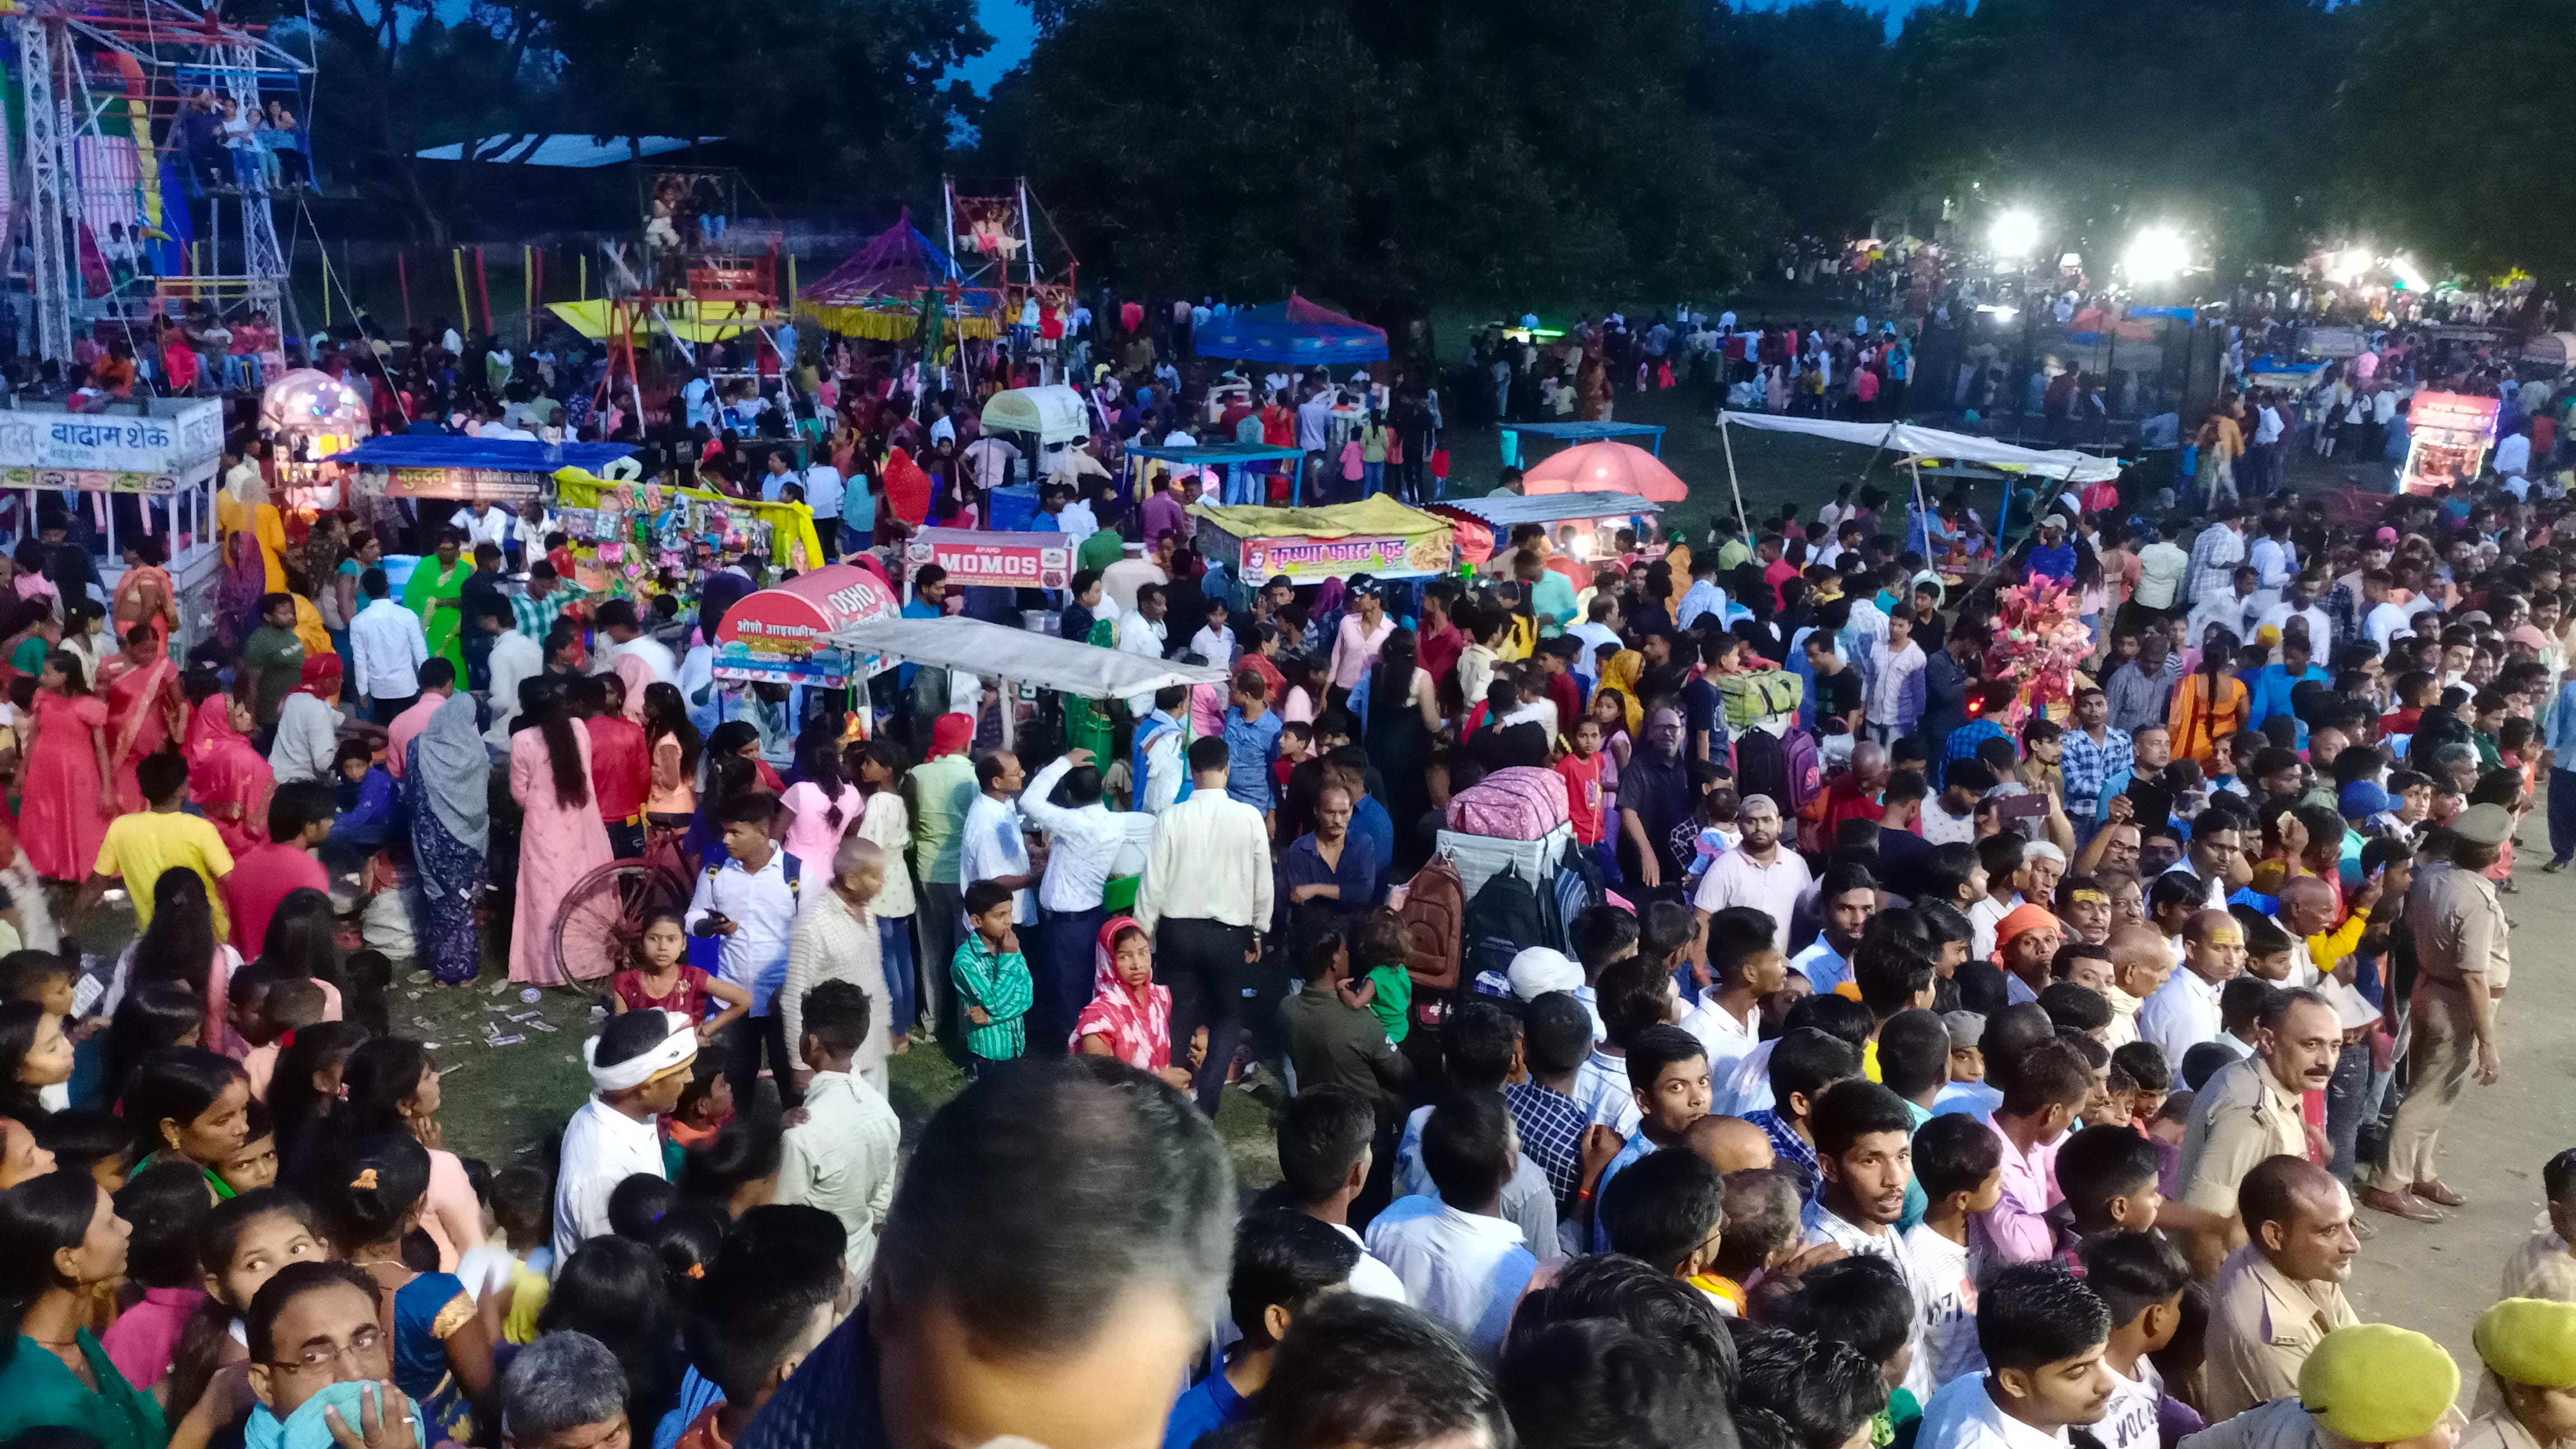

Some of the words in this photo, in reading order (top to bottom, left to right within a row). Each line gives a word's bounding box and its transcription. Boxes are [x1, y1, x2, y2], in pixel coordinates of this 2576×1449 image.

[126, 421, 169, 448] शेक
[938, 553, 1038, 575] MOMOS
[1270, 544, 1324, 571] कृष्णा
[1326, 542, 1372, 564] फास्ट
[1376, 539, 1407, 567] फूड
[827, 583, 876, 615] OSHO
